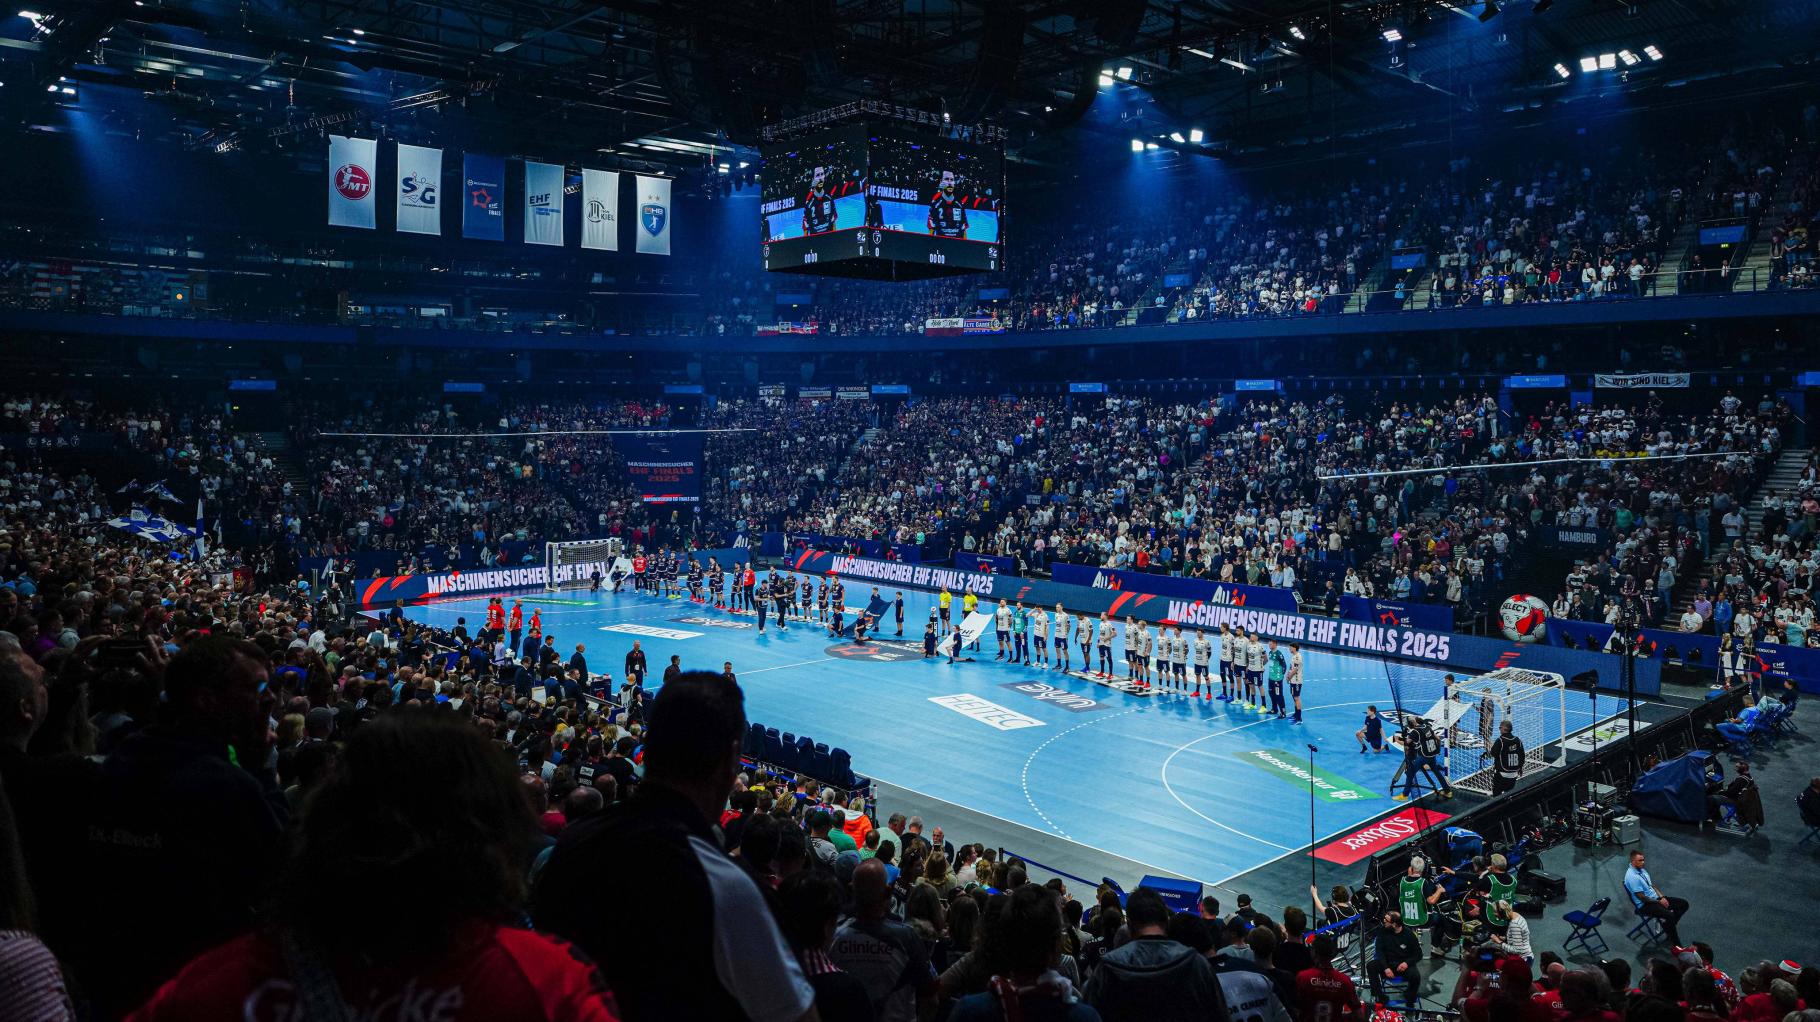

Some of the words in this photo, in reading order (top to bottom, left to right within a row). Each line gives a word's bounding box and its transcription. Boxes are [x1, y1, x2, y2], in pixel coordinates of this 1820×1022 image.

[348, 182, 369, 192] MT
[877, 185, 900, 199] FINALS
[901, 189, 918, 201] 2025
[529, 193, 550, 205] EHF
[1632, 376, 1650, 385] SIND
[1653, 376, 1670, 385] KIEL
[1558, 530, 1597, 544] HAMBURG
[427, 566, 550, 595] MASCHINENSUCHER
[831, 555, 912, 583] MASCHINENSUCHER
[913, 568, 932, 586] EHF
[931, 569, 964, 590] FINALS
[966, 573, 994, 595] 2025
[1502, 602, 1527, 613] SELECT
[1167, 600, 1305, 640] MASCHINENSUCHER
[1307, 617, 1337, 644] EHF
[1339, 623, 1398, 652] FINALS
[1401, 632, 1450, 661] 2025
[937, 695, 1035, 728] HEITEC
[1507, 753, 1519, 767] HB
[1250, 750, 1338, 790] HanseMerkur
[1341, 816, 1415, 850] s.Oliver
[838, 940, 892, 954] Glinicke
[1310, 977, 1342, 989] Glinicke
